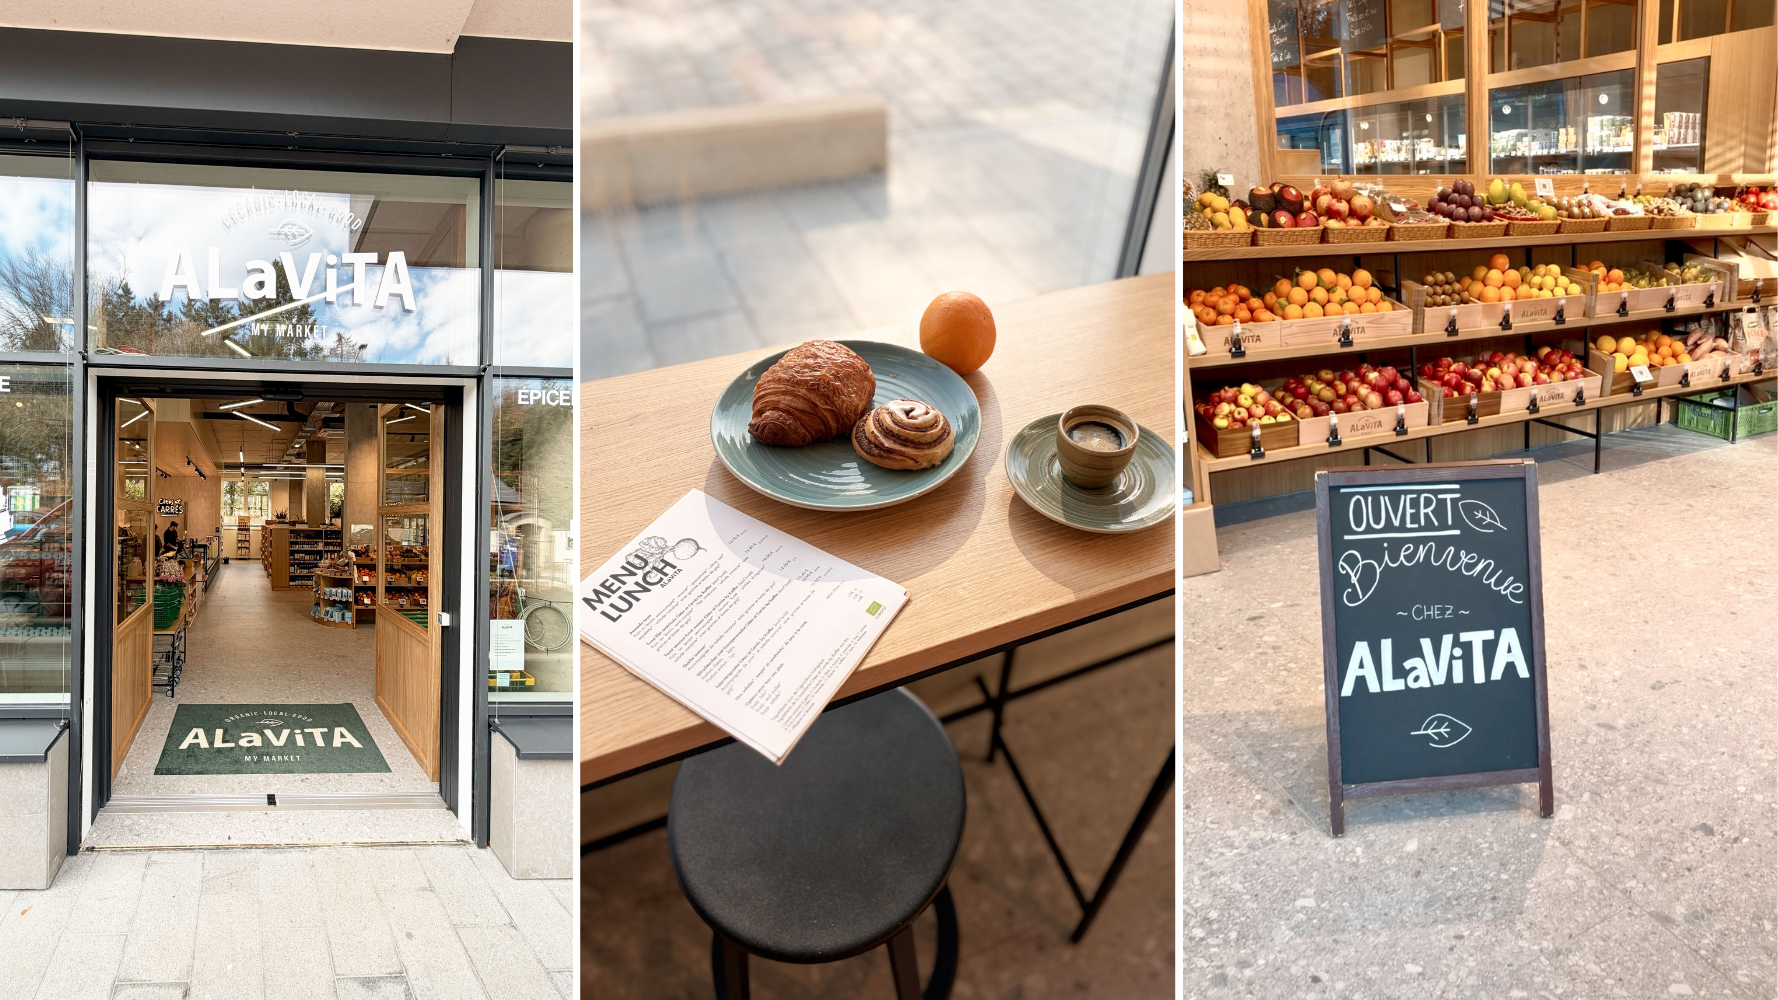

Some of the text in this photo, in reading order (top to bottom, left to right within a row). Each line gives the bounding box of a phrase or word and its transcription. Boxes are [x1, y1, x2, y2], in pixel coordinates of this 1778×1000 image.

[159, 242, 417, 311] ALaViTA
[252, 322, 328, 338] MY MARKET
[518, 386, 573, 406] ÉPICE
[1350, 493, 1461, 532] OUVERT
[582, 554, 648, 611] MENU
[600, 559, 677, 622] LUNCH
[1338, 542, 1524, 606] Bienvenue
[1412, 604, 1454, 620] CHEZ
[1340, 628, 1530, 697] ALaViTA
[224, 712, 258, 722] ORGANIC
[178, 727, 364, 750] ALaViTA
